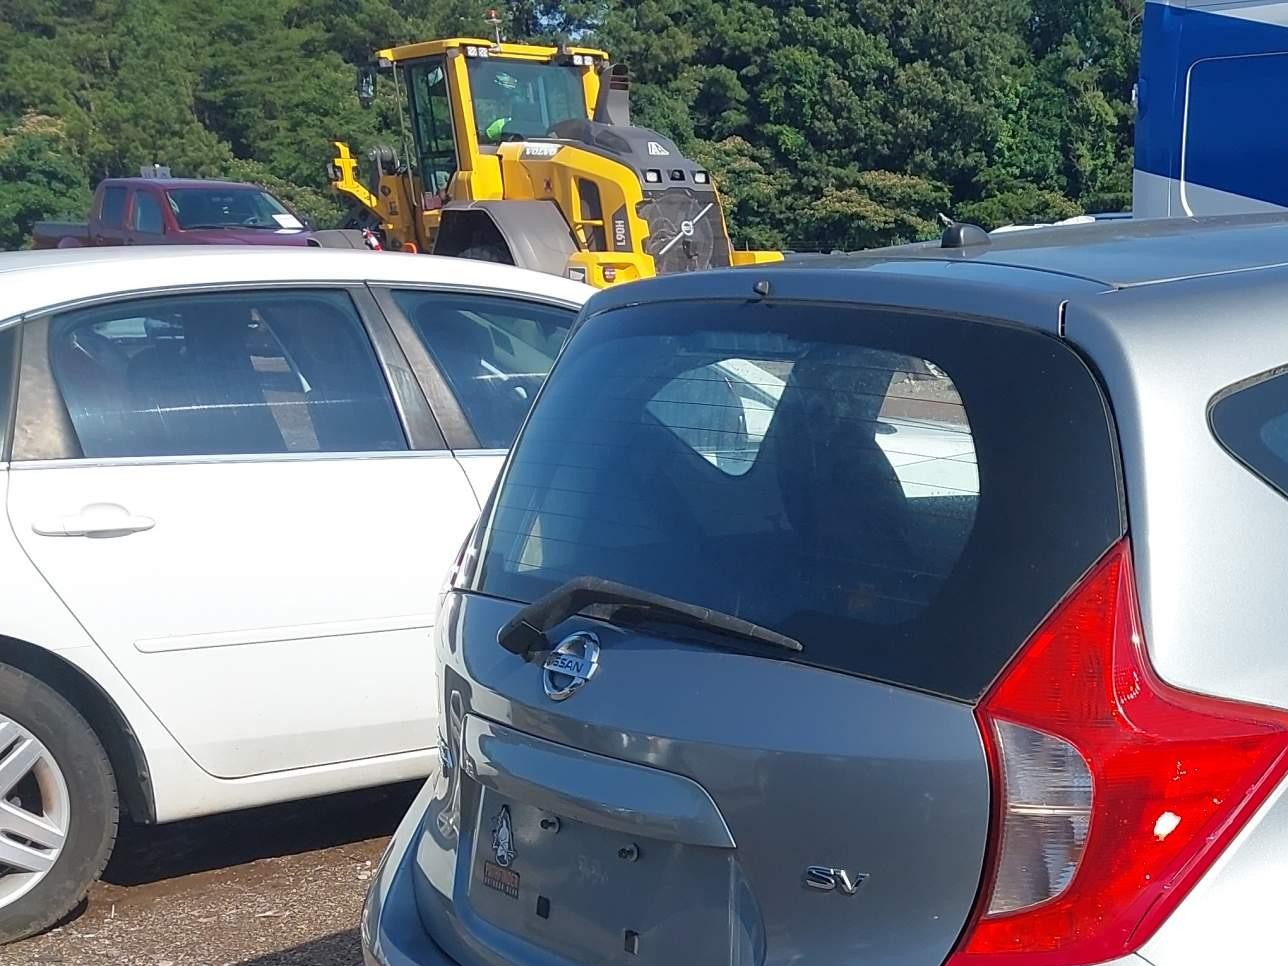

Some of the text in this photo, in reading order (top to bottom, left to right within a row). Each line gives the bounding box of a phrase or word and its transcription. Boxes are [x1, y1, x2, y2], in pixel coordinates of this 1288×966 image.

[615, 220, 626, 246] L90H
[547, 656, 584, 673] SSAN
[806, 865, 870, 895] SV
